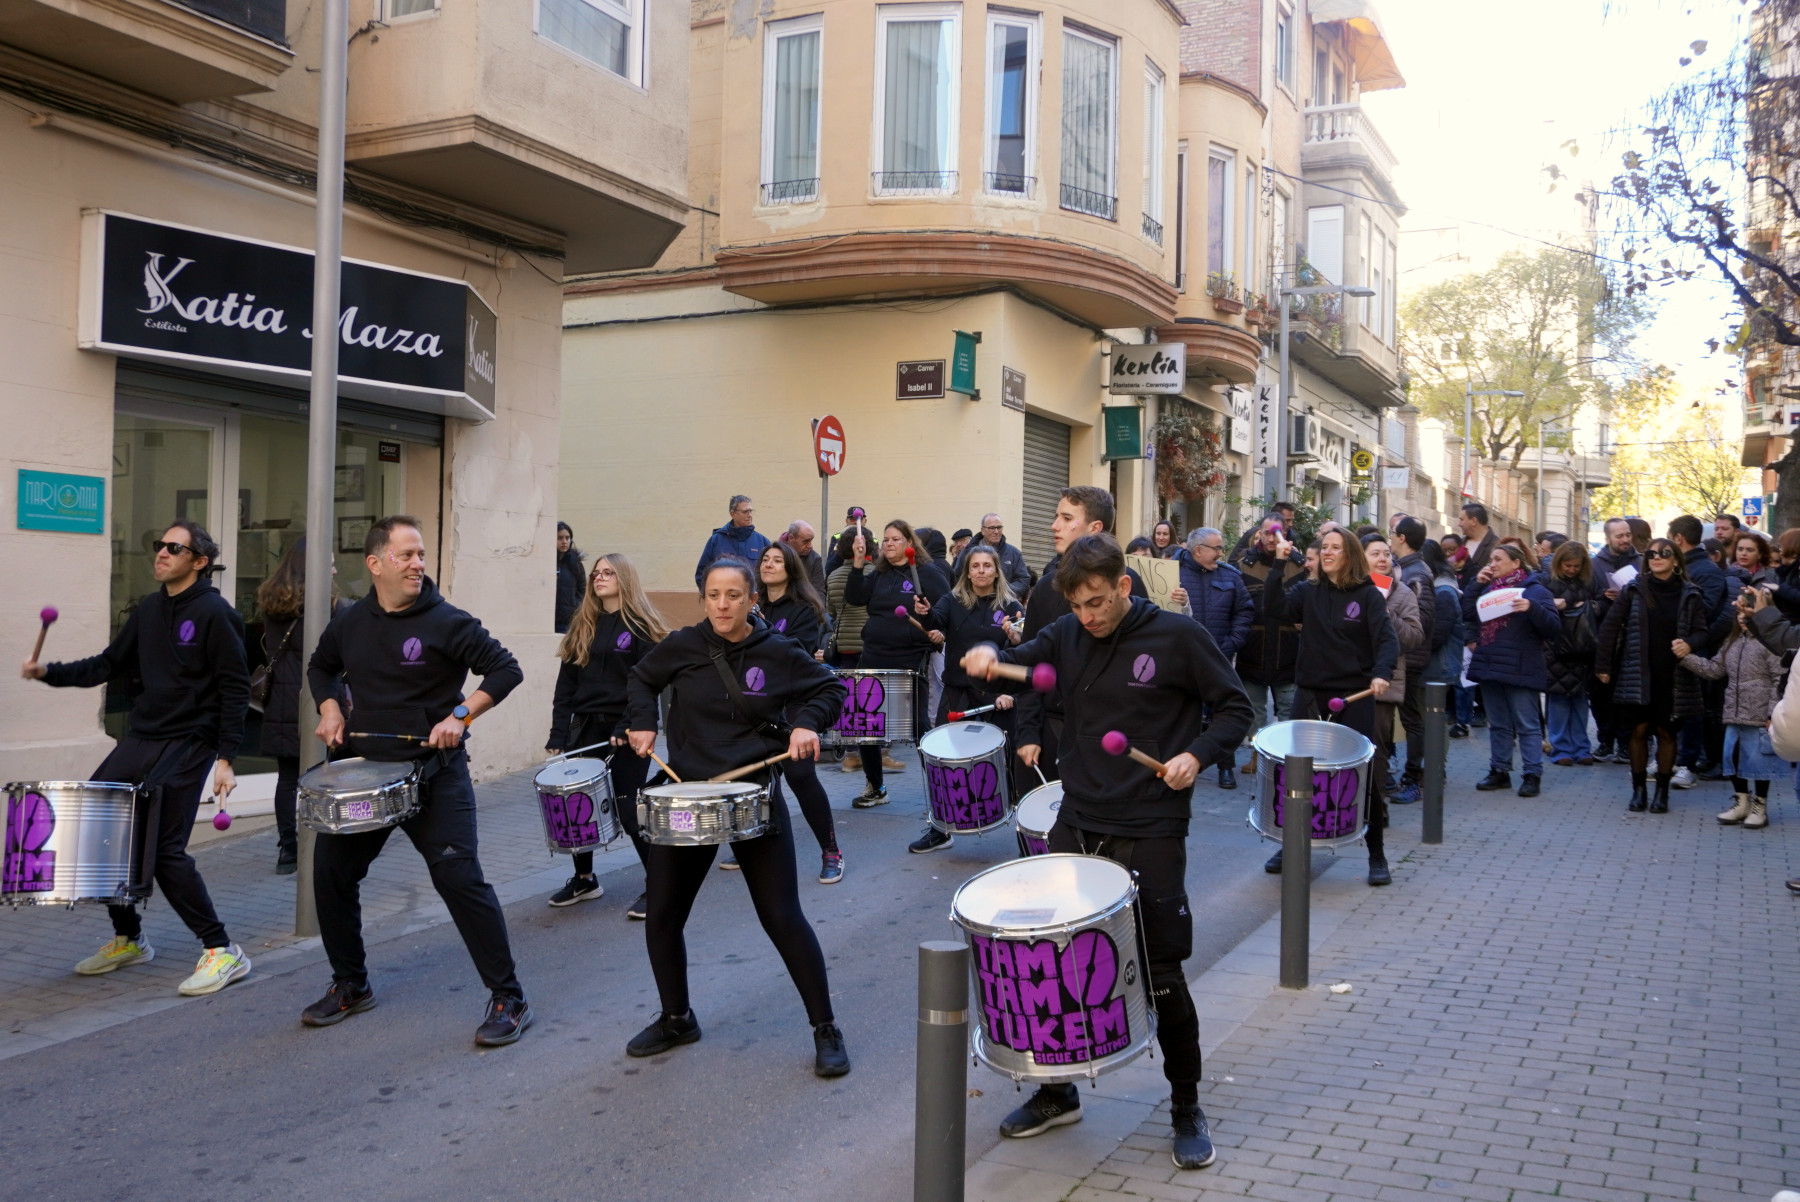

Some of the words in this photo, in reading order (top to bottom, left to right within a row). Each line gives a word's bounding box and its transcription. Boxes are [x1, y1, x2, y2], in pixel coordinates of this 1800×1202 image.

[136, 251, 288, 334] Katia
[144, 318, 188, 333] Estilista
[468, 314, 495, 384] Katia
[907, 384, 926, 392] Isabel
[928, 383, 933, 391] II
[933, 793, 1004, 823] TUKEM
[973, 935, 1058, 979] TAM
[979, 968, 1062, 1015] TAM
[984, 996, 1129, 1051] TUKEM
[1034, 1052, 1073, 1064] SIGUE
[1095, 1035, 1129, 1056] RITMO
